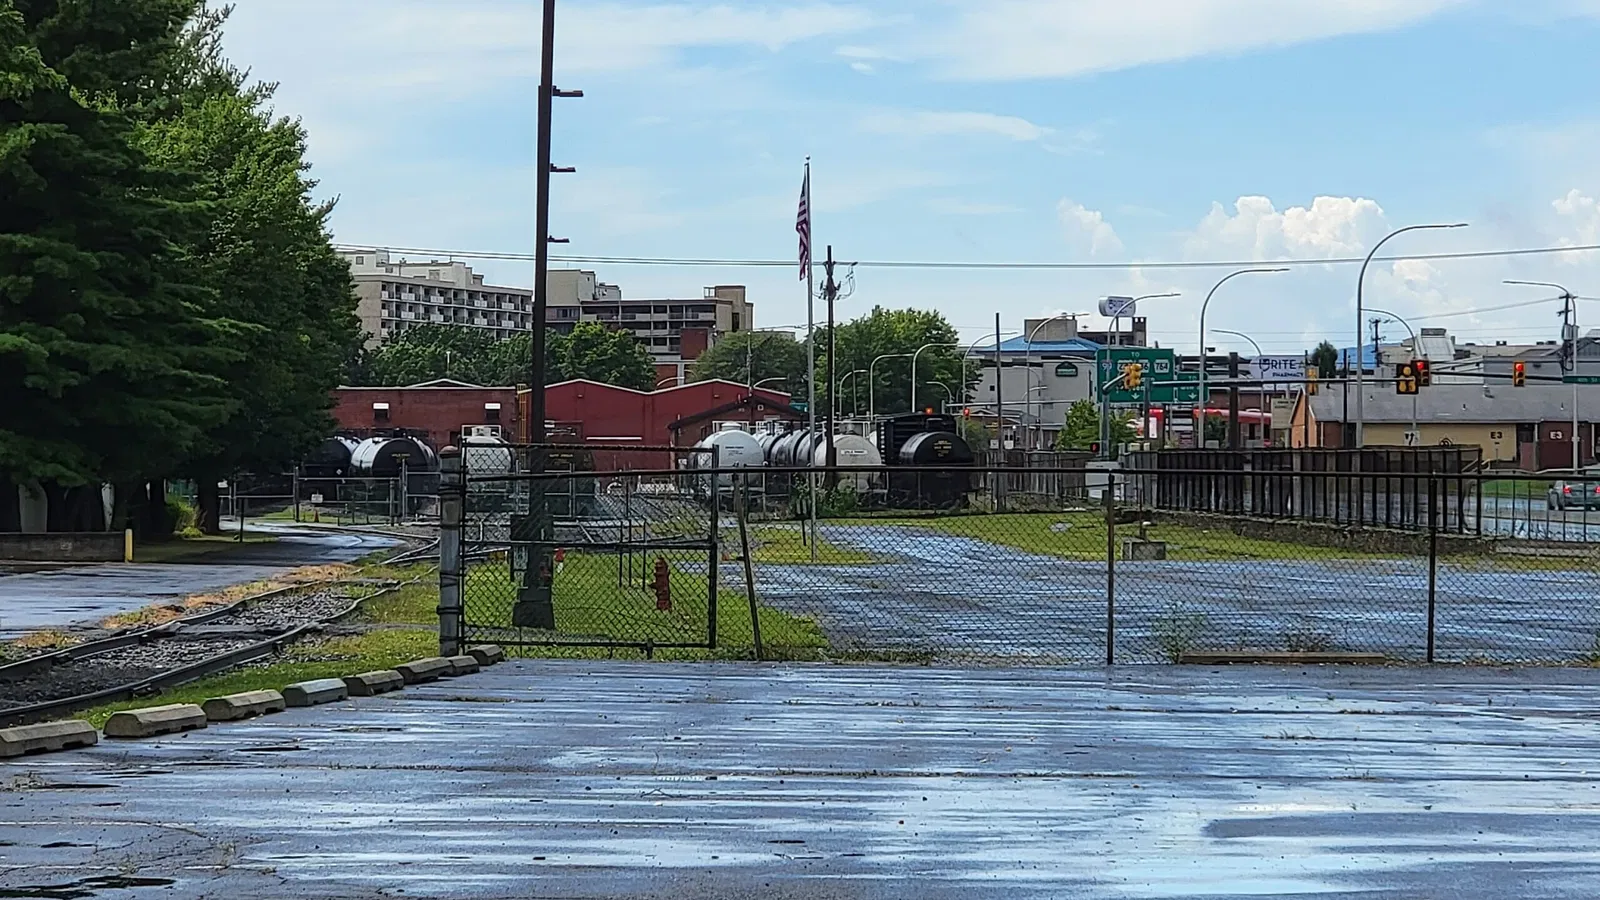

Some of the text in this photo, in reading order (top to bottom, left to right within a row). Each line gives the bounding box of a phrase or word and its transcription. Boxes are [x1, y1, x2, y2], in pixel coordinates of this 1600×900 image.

[1156, 362, 1168, 370] 764
[1271, 359, 1296, 369] RITE
[1490, 431, 1503, 439] E3
[1549, 431, 1563, 439] E3
